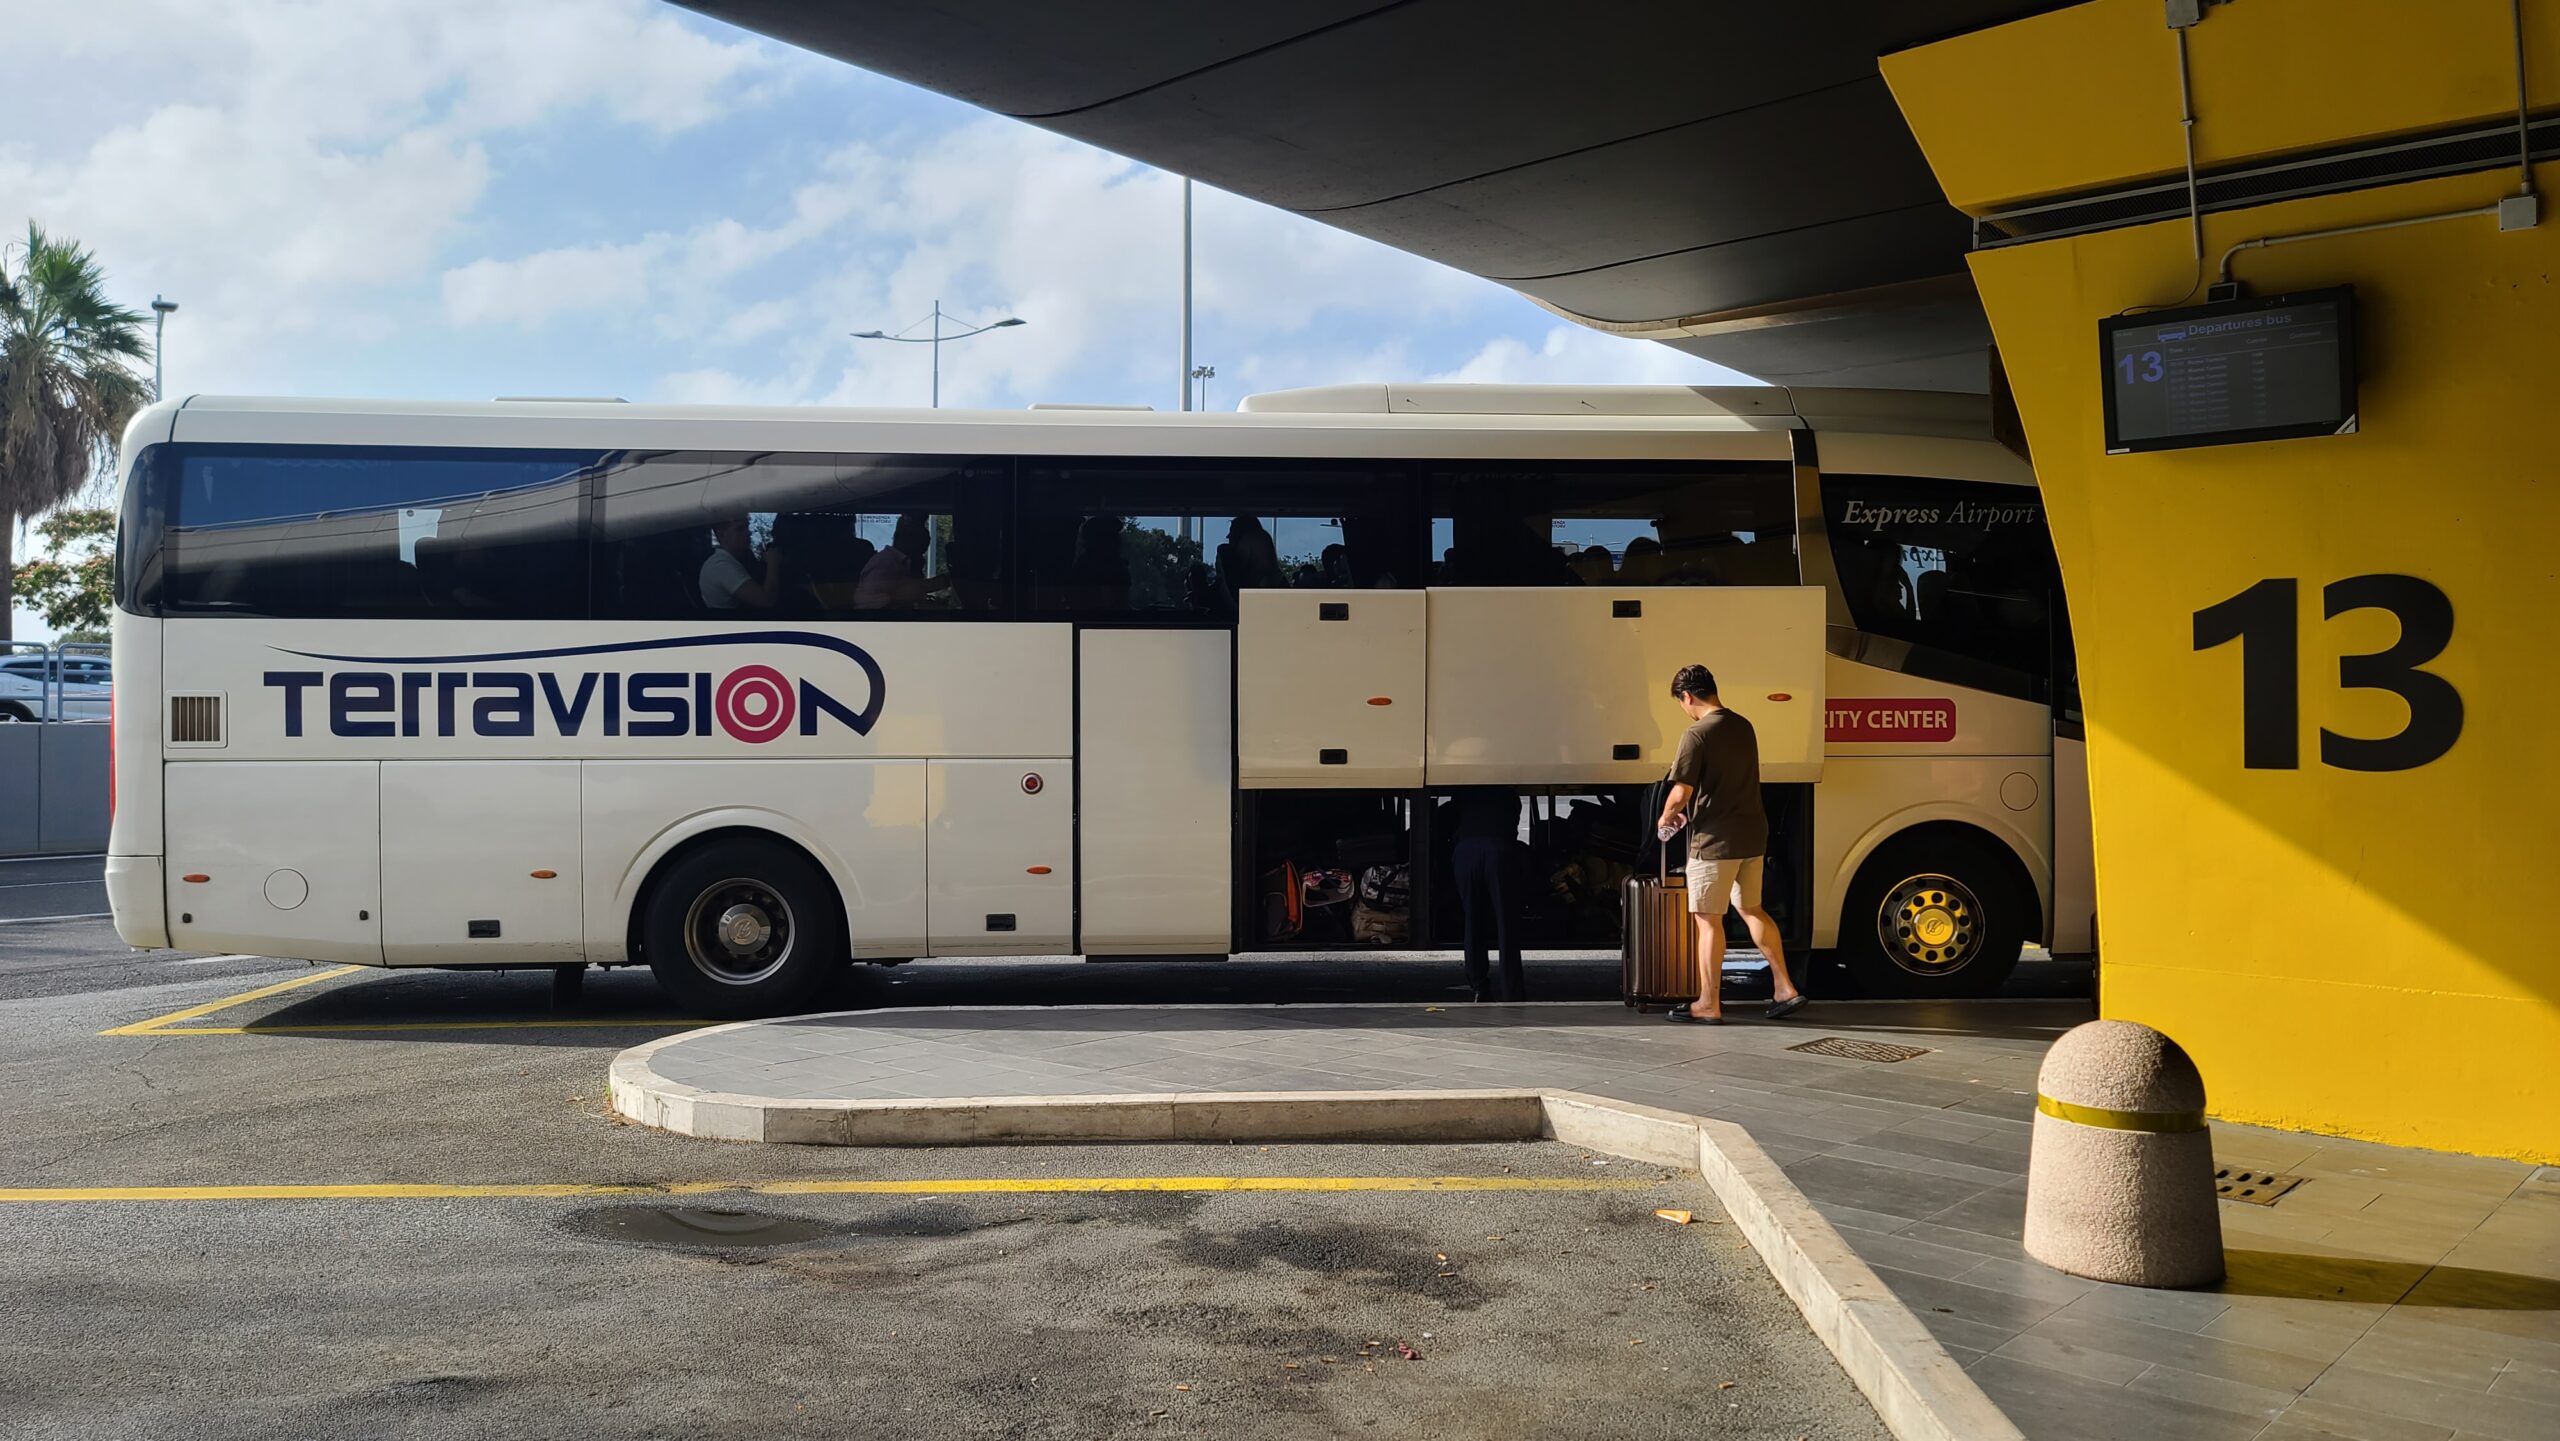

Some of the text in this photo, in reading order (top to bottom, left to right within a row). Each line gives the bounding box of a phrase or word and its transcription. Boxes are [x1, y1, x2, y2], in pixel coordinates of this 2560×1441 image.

[2188, 313, 2292, 337] Departures bus
[2118, 350, 2164, 385] 13
[1842, 500, 1940, 532] Express
[1946, 500, 2036, 532] Airport
[2192, 573, 2465, 773] 13
[1825, 710, 1948, 730] ITY CENTER
